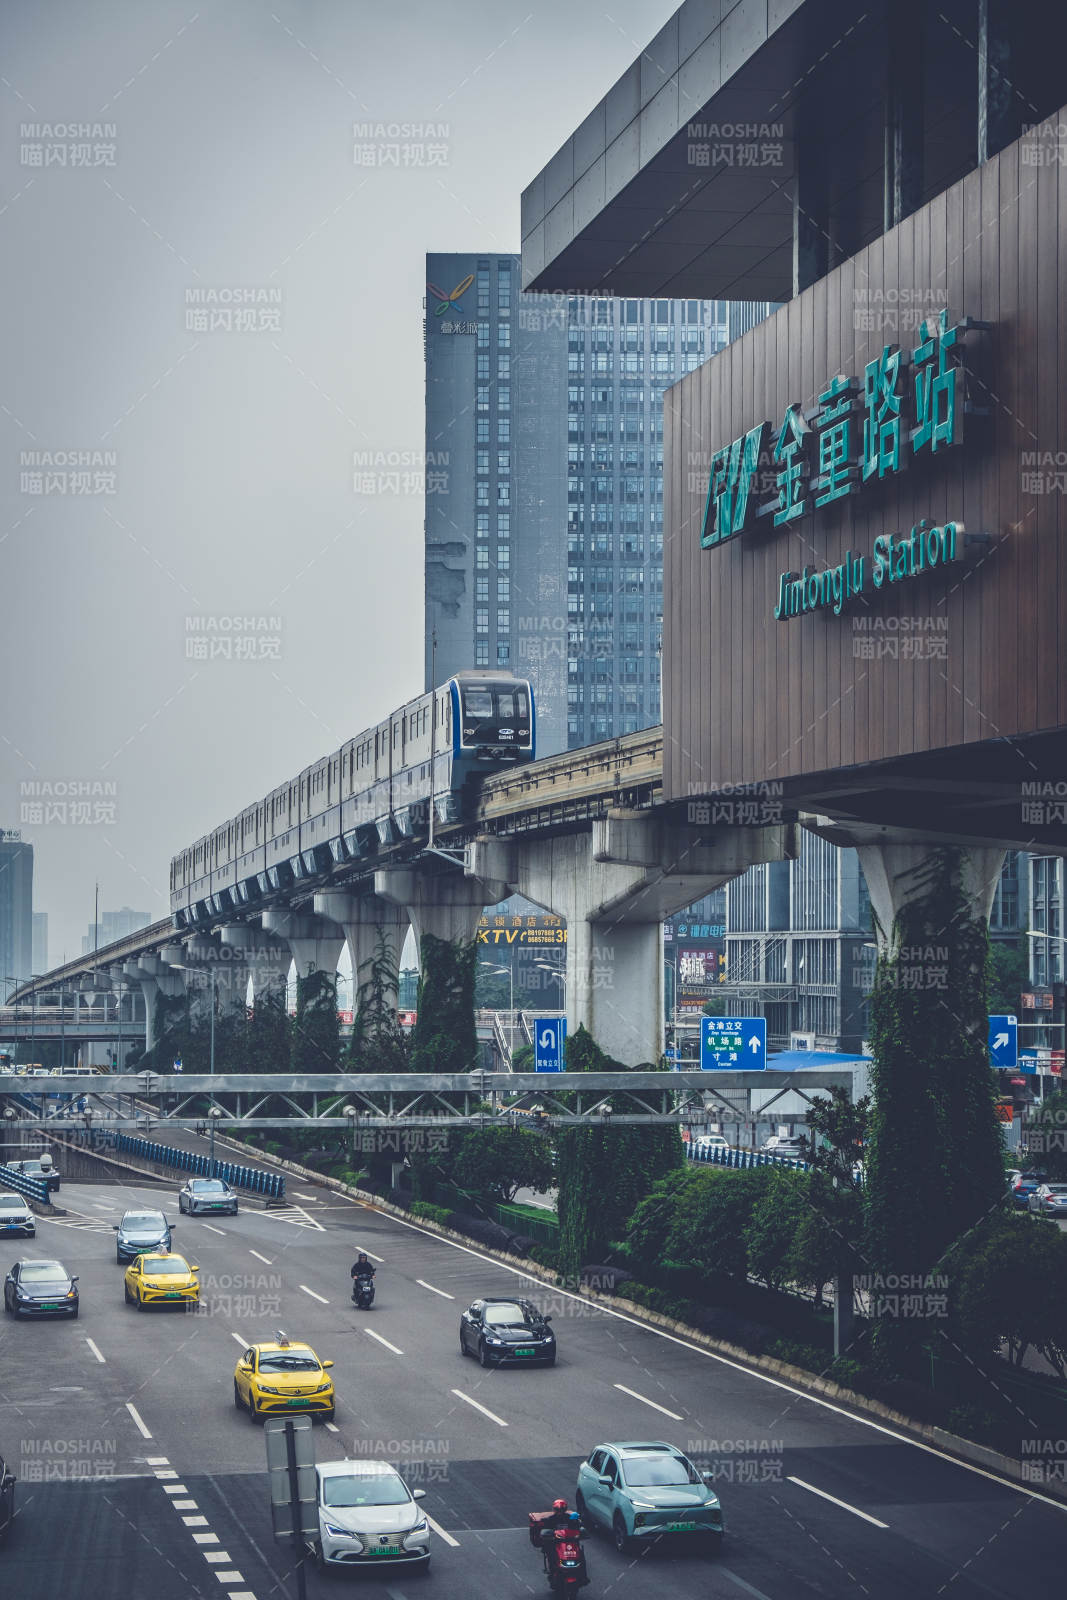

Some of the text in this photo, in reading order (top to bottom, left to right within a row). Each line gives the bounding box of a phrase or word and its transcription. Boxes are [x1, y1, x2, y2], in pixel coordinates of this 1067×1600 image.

[773, 308, 957, 528] 金童路站
[773, 519, 957, 621] Jintonglu Station
[479, 916, 537, 927] 连锁酒店
[477, 929, 518, 943] KTV
[707, 1021, 743, 1031] 金渝立交
[707, 1036, 742, 1046] 机场路
[712, 1052, 737, 1061] 寸滩
